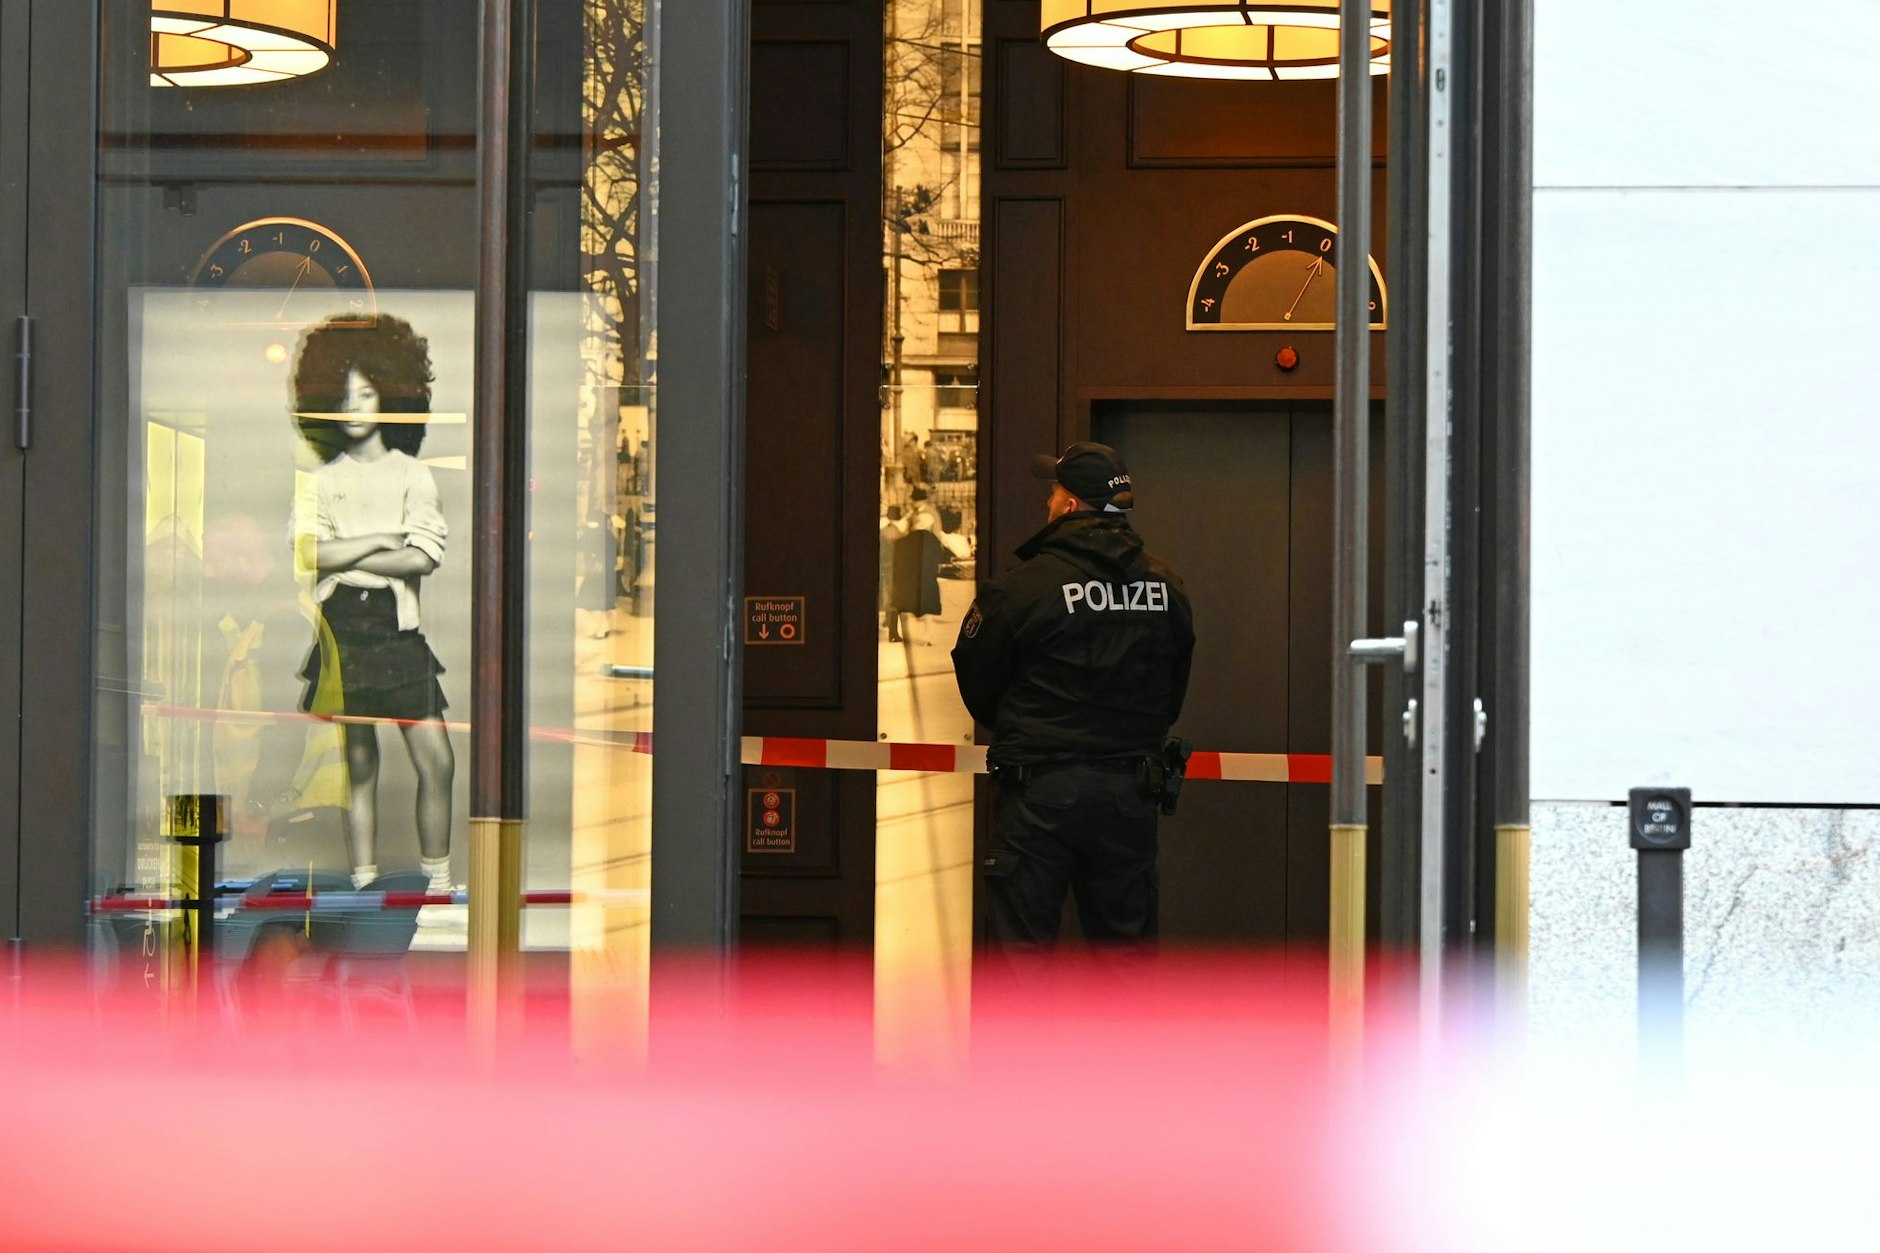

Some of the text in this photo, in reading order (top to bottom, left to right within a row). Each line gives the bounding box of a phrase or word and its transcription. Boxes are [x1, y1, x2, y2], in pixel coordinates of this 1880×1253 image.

[238, 239, 252, 254] -2
[272, 232, 283, 245] -1
[310, 239, 320, 252] 0
[1201, 230, 1331, 312] -4 -3 -2 -1 0
[1108, 474, 1131, 489] POLIZ
[1062, 580, 1168, 614] POLIZEI
[755, 601, 794, 612] Rufknopf
[752, 613, 797, 622] call button
[1647, 801, 1672, 811] MALL
[1652, 812, 1667, 822] OF
[755, 828, 787, 837] Rufknopf
[752, 838, 790, 846] call button
